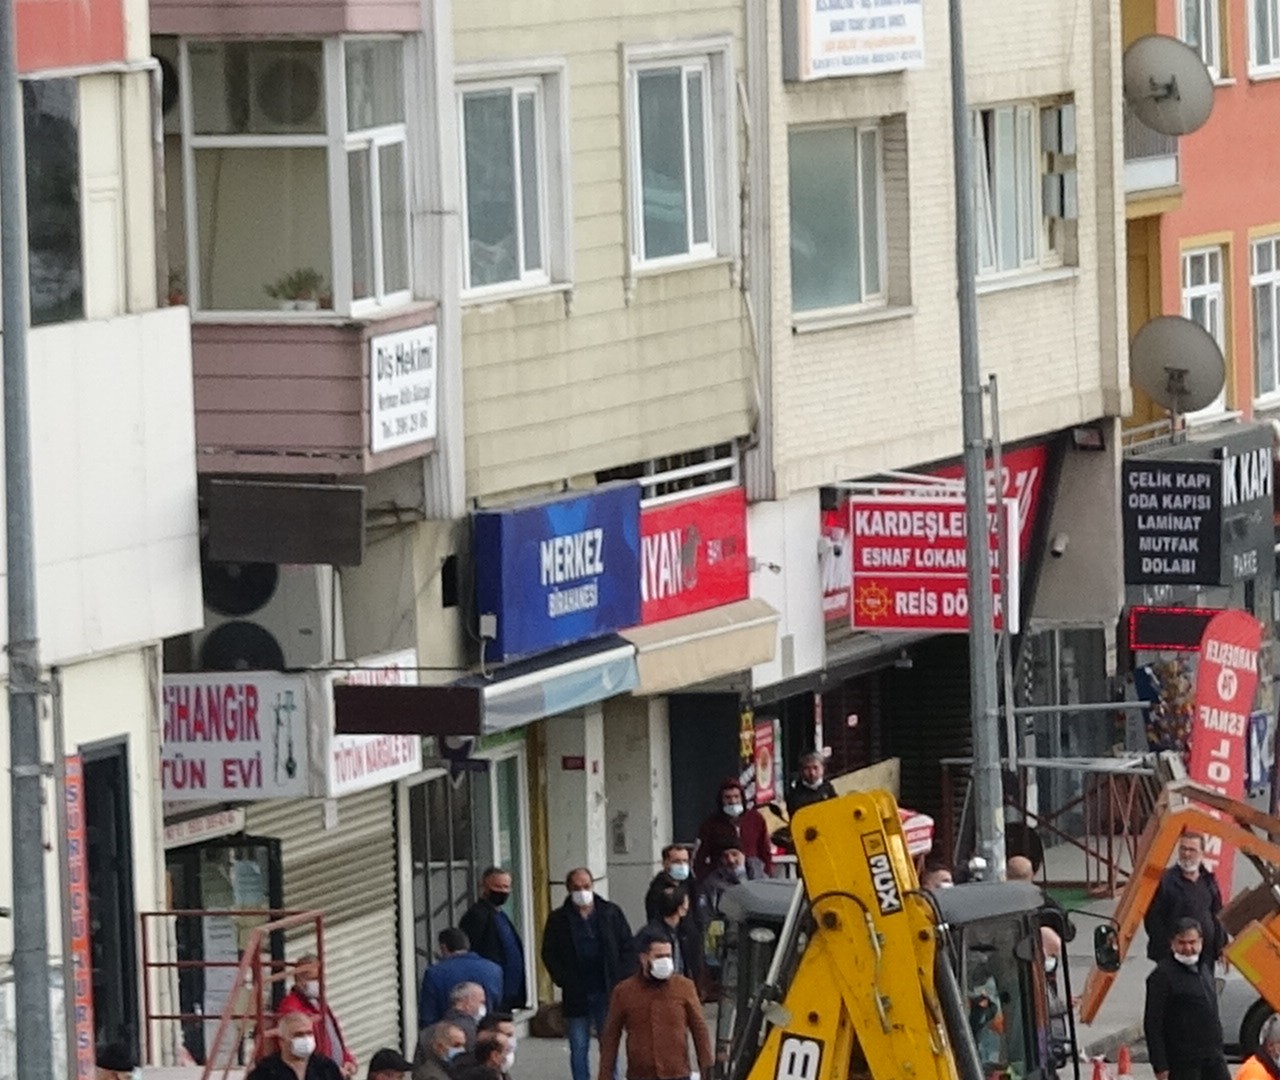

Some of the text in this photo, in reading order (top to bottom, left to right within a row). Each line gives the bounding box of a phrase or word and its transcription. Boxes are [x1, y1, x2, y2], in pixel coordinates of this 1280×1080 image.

[1128, 469, 1211, 490] ÇELİK KAPI
[1239, 447, 1272, 503] KAPI
[1128, 493, 1211, 510] ODA KAPISI
[855, 510, 968, 544] KARDEŞLE
[1137, 513, 1202, 531] LAMİNAT
[1138, 536, 1200, 552] MUTFAK
[540, 528, 604, 586] MERKEZ
[861, 547, 912, 568] ESNAF
[1141, 557, 1197, 575] DOLABI
[895, 587, 939, 615] REİS
[222, 752, 264, 789] EVİ
[869, 856, 900, 912] 3CX
